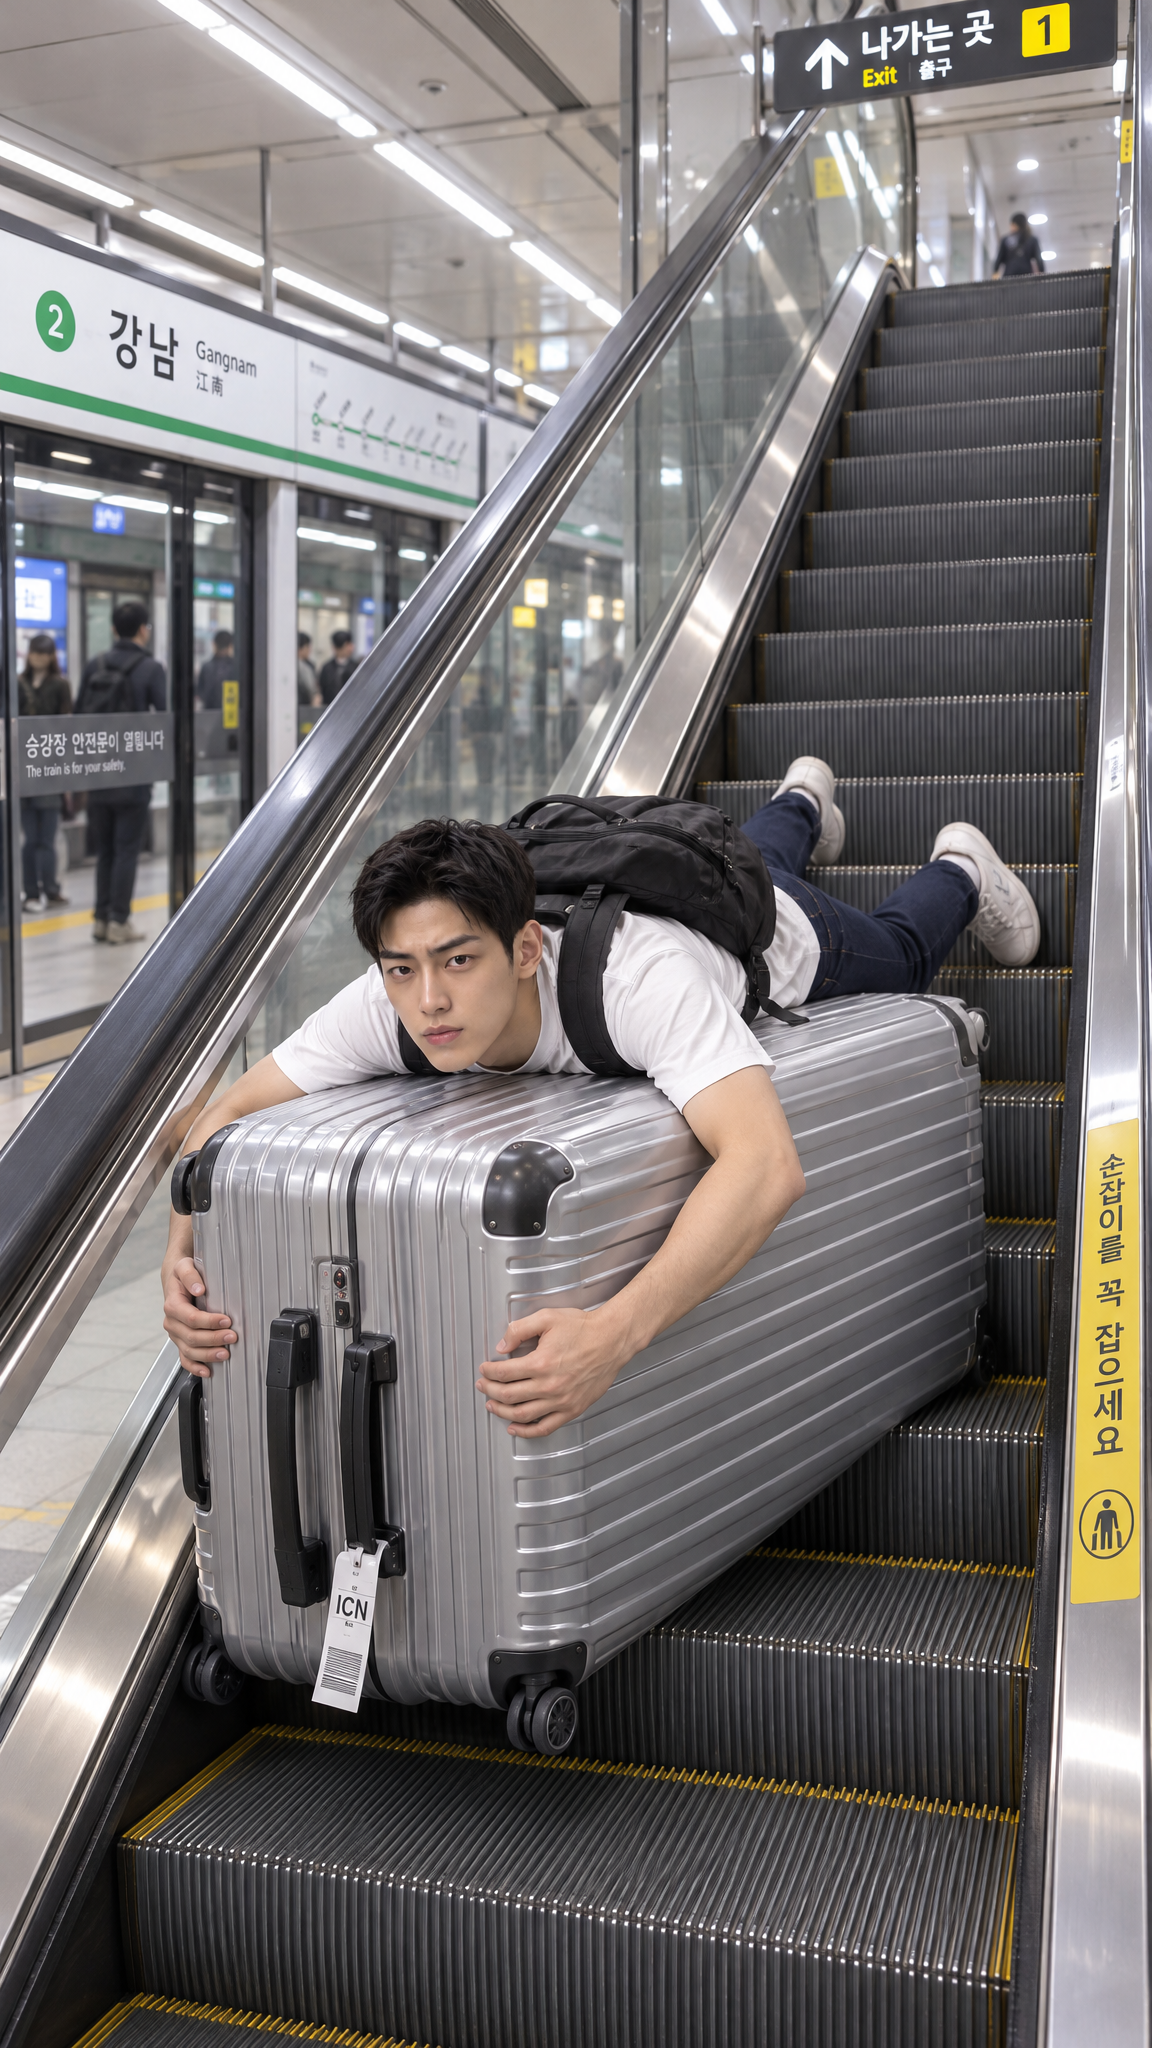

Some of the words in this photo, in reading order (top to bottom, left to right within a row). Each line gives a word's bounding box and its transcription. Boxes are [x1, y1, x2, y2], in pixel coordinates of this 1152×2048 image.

[862, 18, 953, 60] 나가는
[962, 9, 995, 48] 곳
[1037, 14, 1051, 46] 1
[863, 66, 899, 89] Exit
[918, 57, 953, 82] 출구
[48, 303, 64, 340] 2
[109, 309, 179, 381] 강남
[195, 340, 257, 378] Gangnam
[196, 370, 224, 397] 江南
[25, 733, 68, 758] 승강장
[72, 731, 119, 755] 안전문이
[26, 765, 42, 778] The
[44, 763, 62, 777] train
[63, 762, 70, 775] is
[72, 761, 83, 774] for
[84, 762, 102, 776] your
[1098, 1153, 1126, 1266] 손잡이를
[1096, 1279, 1125, 1307] 꼭
[1093, 1322, 1125, 1456] 잡으세요
[336, 1594, 368, 1621] ICN
